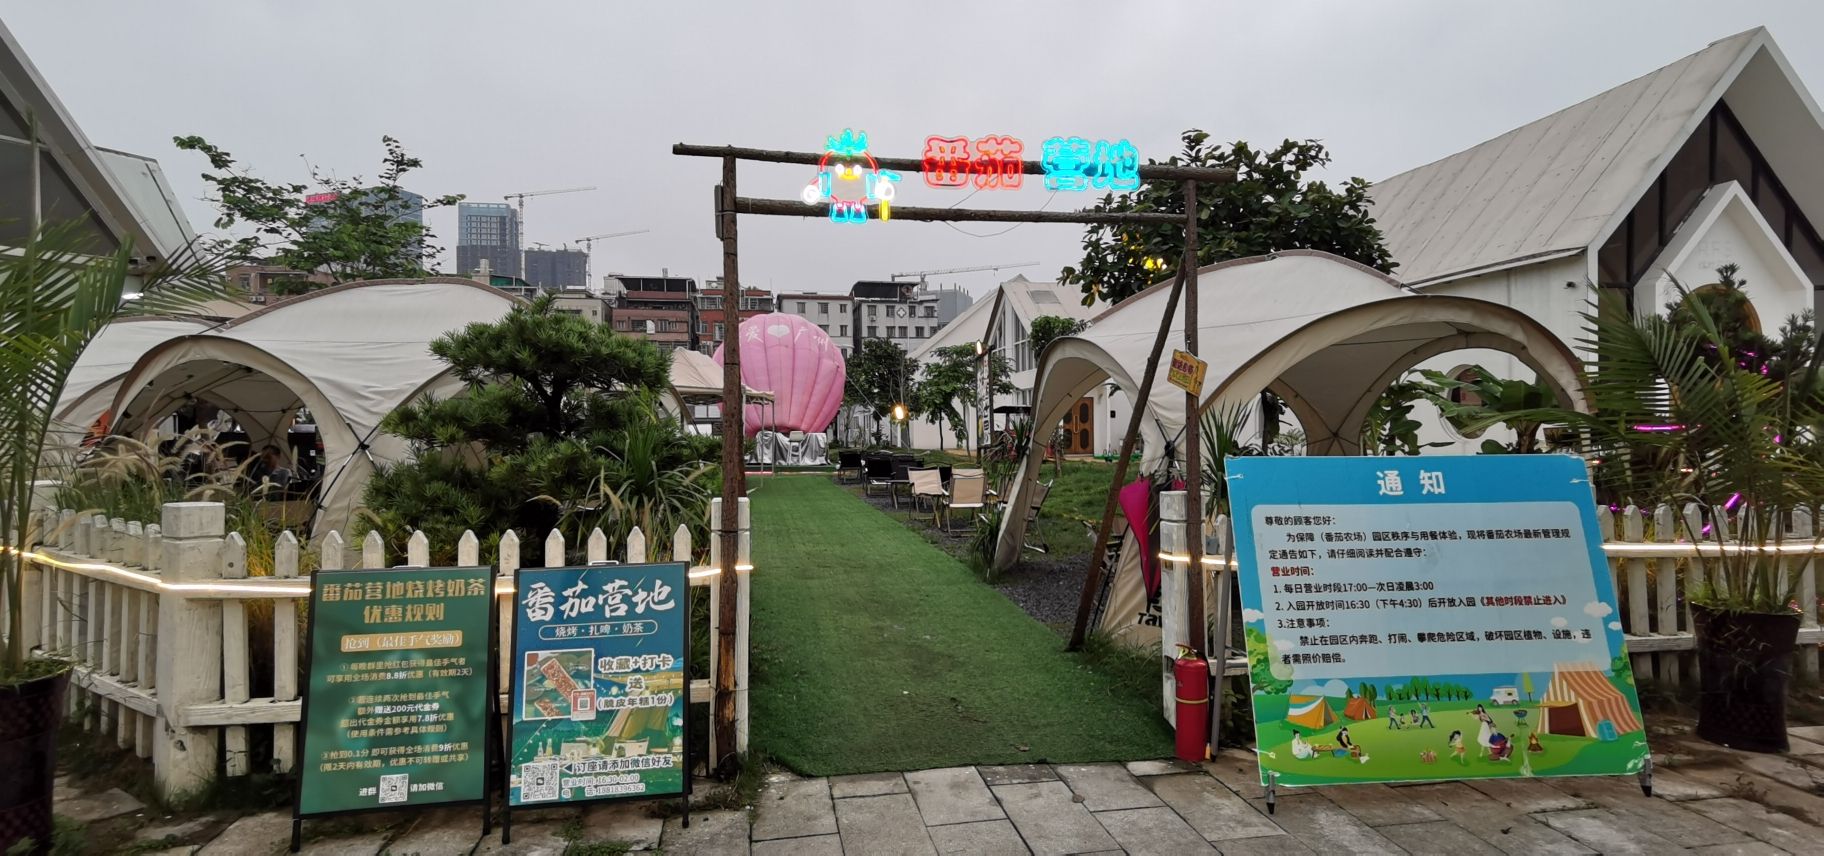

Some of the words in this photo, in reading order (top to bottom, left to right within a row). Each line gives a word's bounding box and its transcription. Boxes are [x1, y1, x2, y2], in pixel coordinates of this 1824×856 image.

[922, 134, 1024, 190] 番茄
[1041, 136, 1141, 191] 营地
[1376, 469, 1446, 496] 通知
[1264, 516, 1337, 526] 尊敬的顾客您好：
[1268, 547, 1428, 560] 定通告如下，请仔细阅读并配合遵守：
[1270, 566, 1315, 577] 营业时间：
[321, 578, 486, 602] 番茄营地烧烤奶茶
[522, 579, 675, 622] 番茄营地
[363, 603, 445, 624] 优惠规则
[1277, 618, 1331, 629] 3.注意事项：
[599, 654, 673, 672] 收藏+打卡
[1281, 653, 1347, 665] 者需照价赔偿。
[628, 676, 644, 691] 送
[576, 756, 673, 773] 订座请添加微信好友
[410, 781, 444, 793] 请加微信
